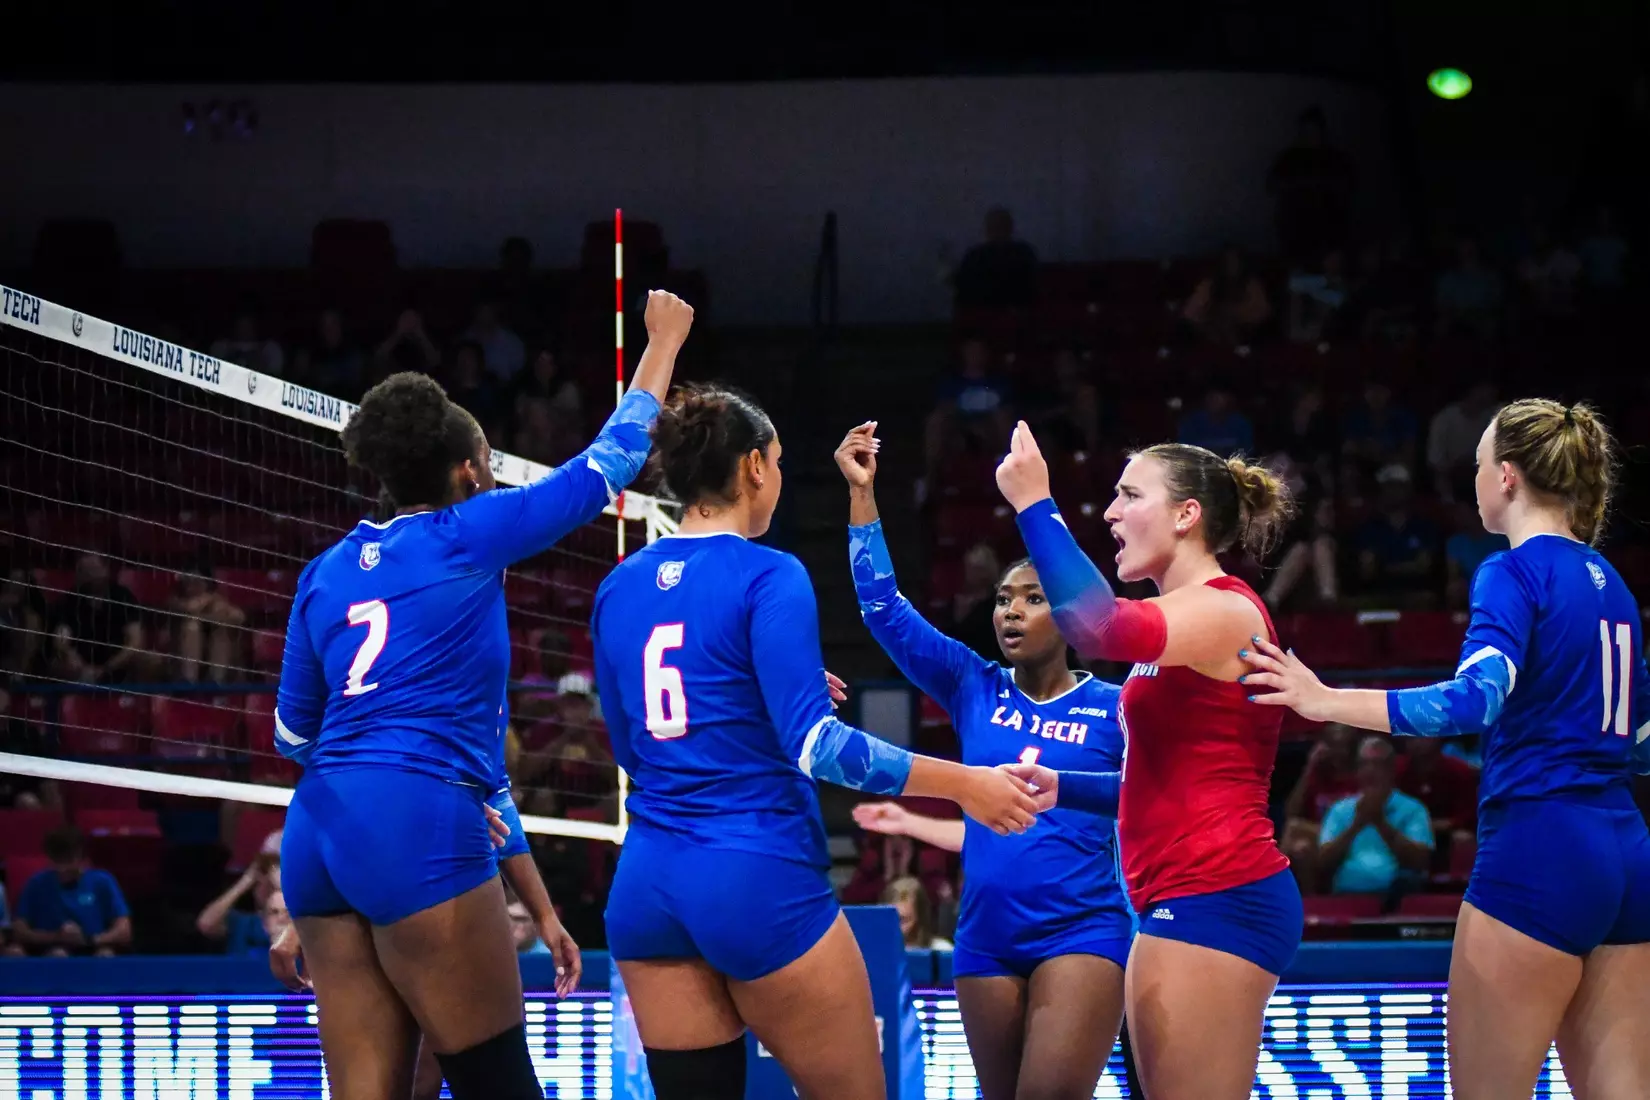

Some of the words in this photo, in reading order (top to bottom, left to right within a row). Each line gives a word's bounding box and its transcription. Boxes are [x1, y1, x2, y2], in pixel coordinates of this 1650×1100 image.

[3, 287, 41, 325] TECH
[112, 325, 184, 373] LOUISIANA
[189, 351, 221, 385] TECH
[281, 382, 341, 424] LOUISIANA
[642, 622, 689, 741] 6
[1600, 619, 1632, 736] 11
[990, 705, 1023, 731] LA
[1029, 714, 1089, 745] TECH
[1152, 910, 1175, 921] adidas
